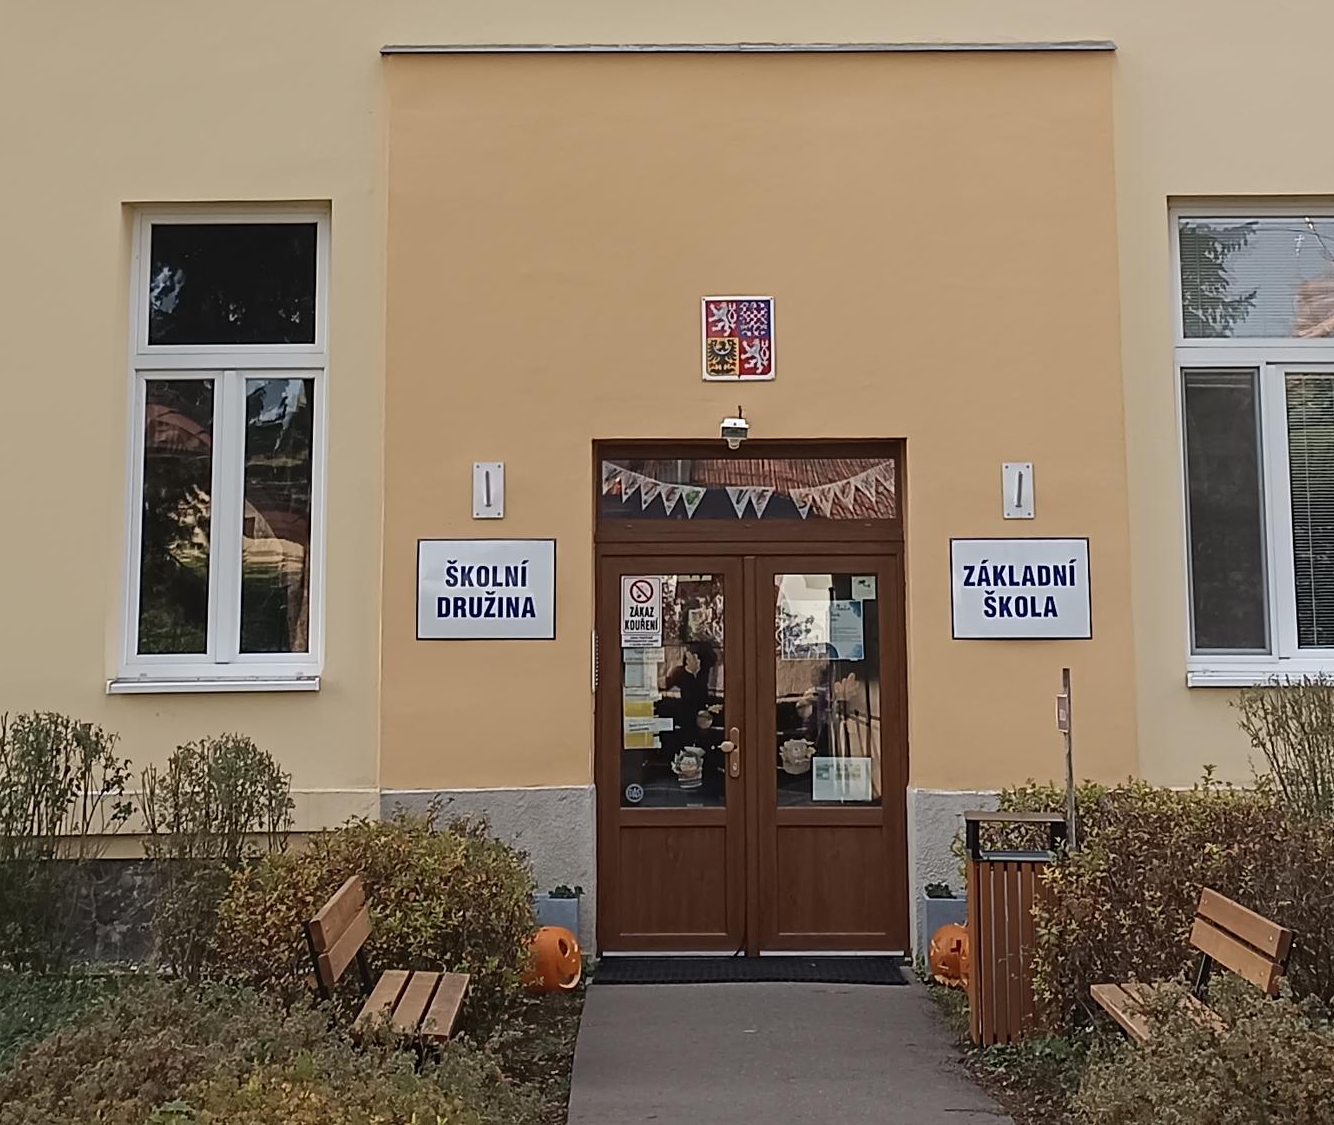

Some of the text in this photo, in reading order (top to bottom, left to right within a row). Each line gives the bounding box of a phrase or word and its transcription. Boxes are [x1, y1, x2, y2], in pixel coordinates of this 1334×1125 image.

[445, 559, 529, 587] ŠKOLNÍ
[963, 558, 1077, 587] ZÁKLADNÍ
[437, 591, 536, 618] DRUŽINA
[629, 604, 655, 618] ZÁKAZ
[984, 590, 1058, 618] ŠKOLA
[624, 617, 658, 631] KOUŘENÍ
